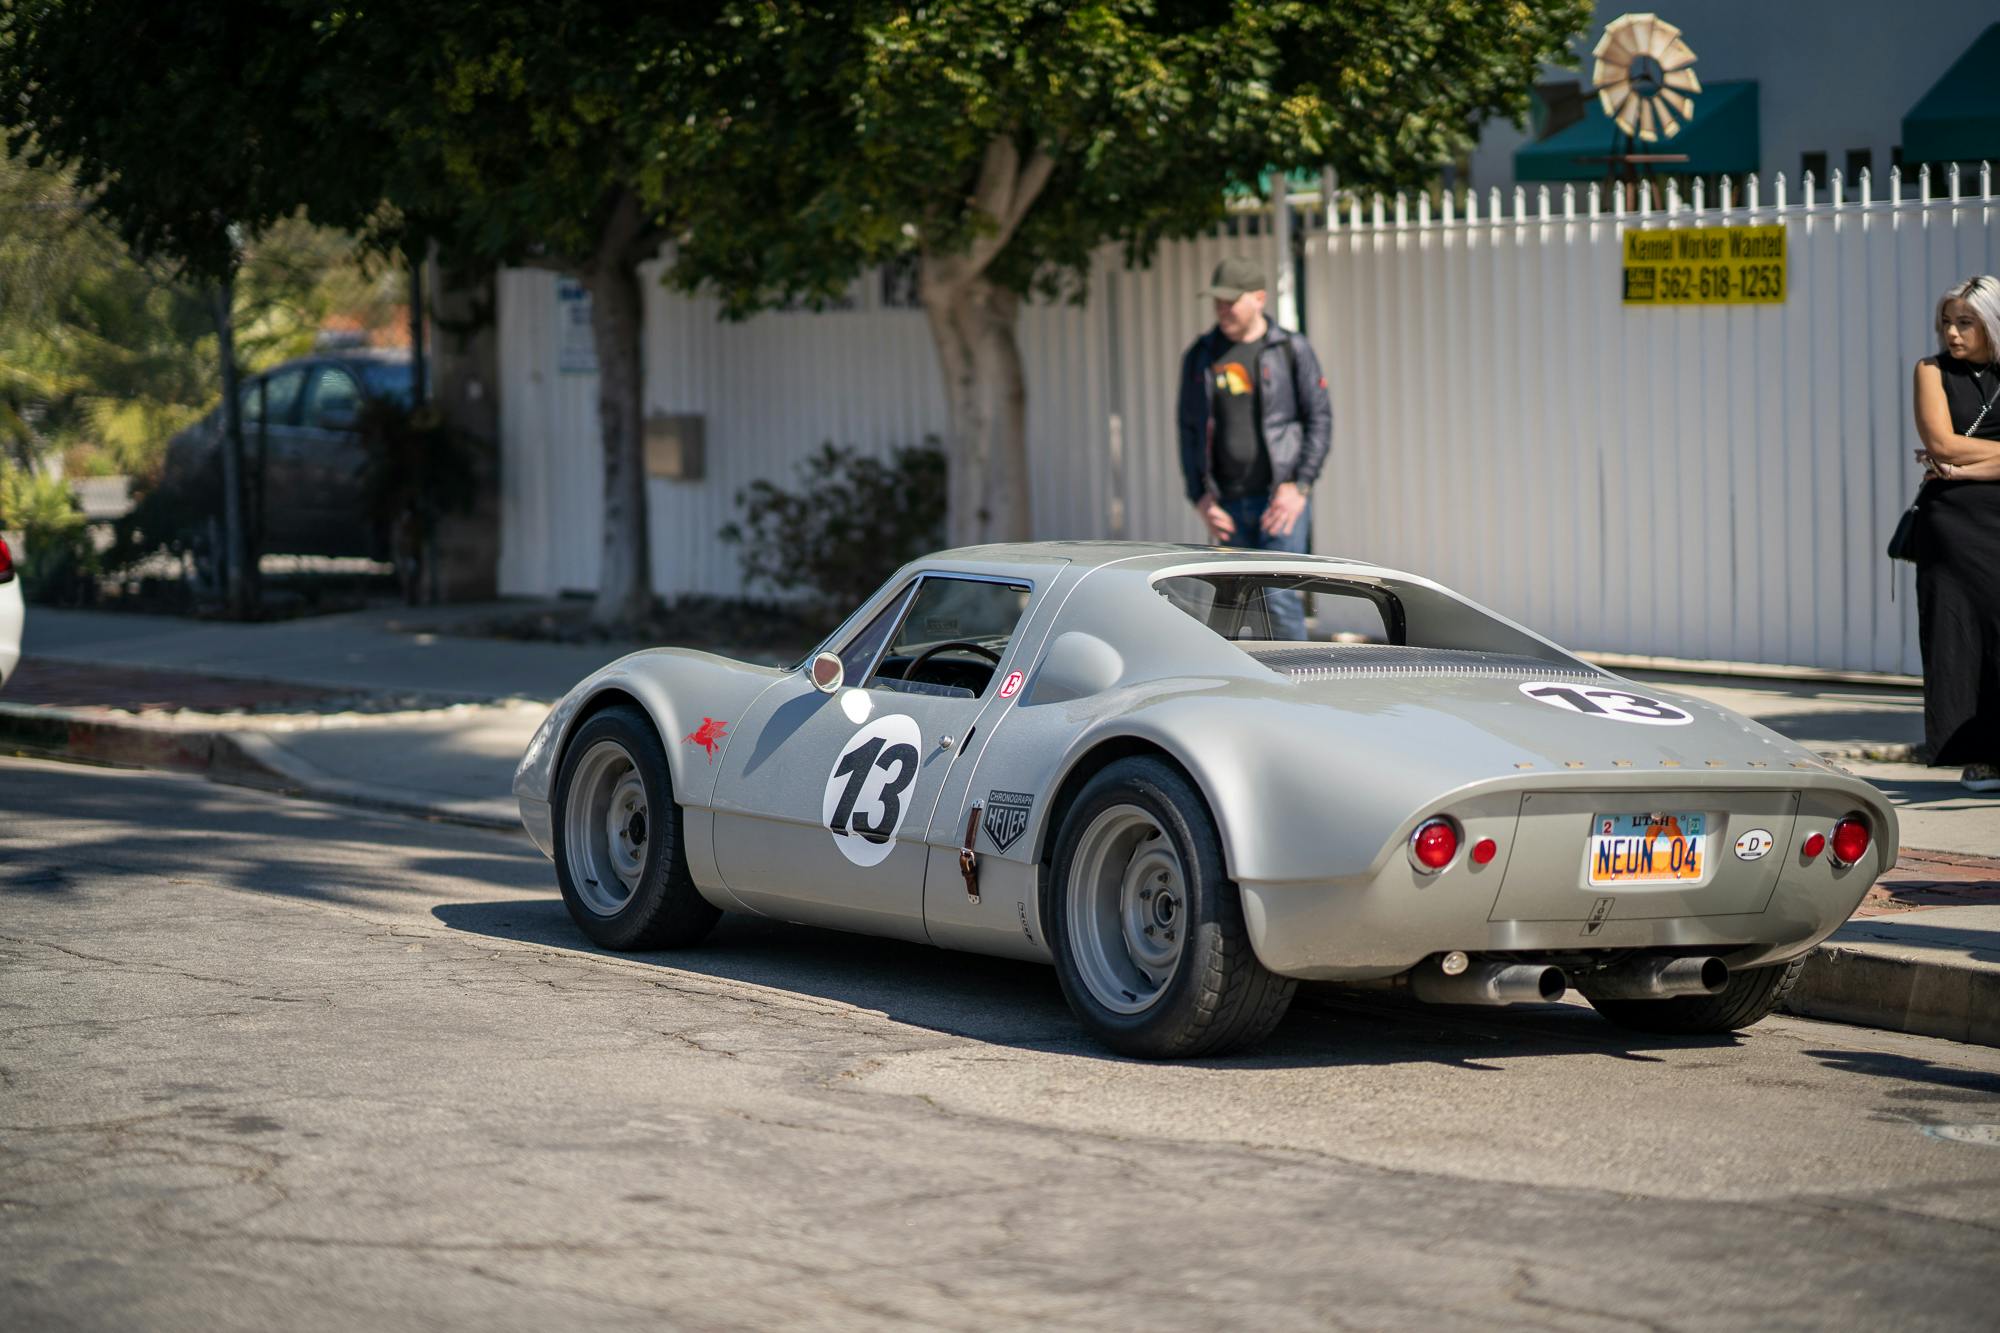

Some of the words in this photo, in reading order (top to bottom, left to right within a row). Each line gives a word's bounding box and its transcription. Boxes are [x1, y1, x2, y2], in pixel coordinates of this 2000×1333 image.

[1678, 232, 1723, 259] Worker
[1729, 230, 1782, 258] Wanted
[1660, 265, 1782, 298] 562-618-1253
[1002, 675, 1020, 694] E
[1527, 687, 1686, 719] 13
[830, 737, 919, 844] 13
[989, 791, 1033, 806] CHRONOGRAPH
[987, 808, 1026, 846] HEUER
[1603, 821, 1612, 834] 2
[1598, 838, 1655, 874] NEUN
[1748, 837, 1760, 851] D
